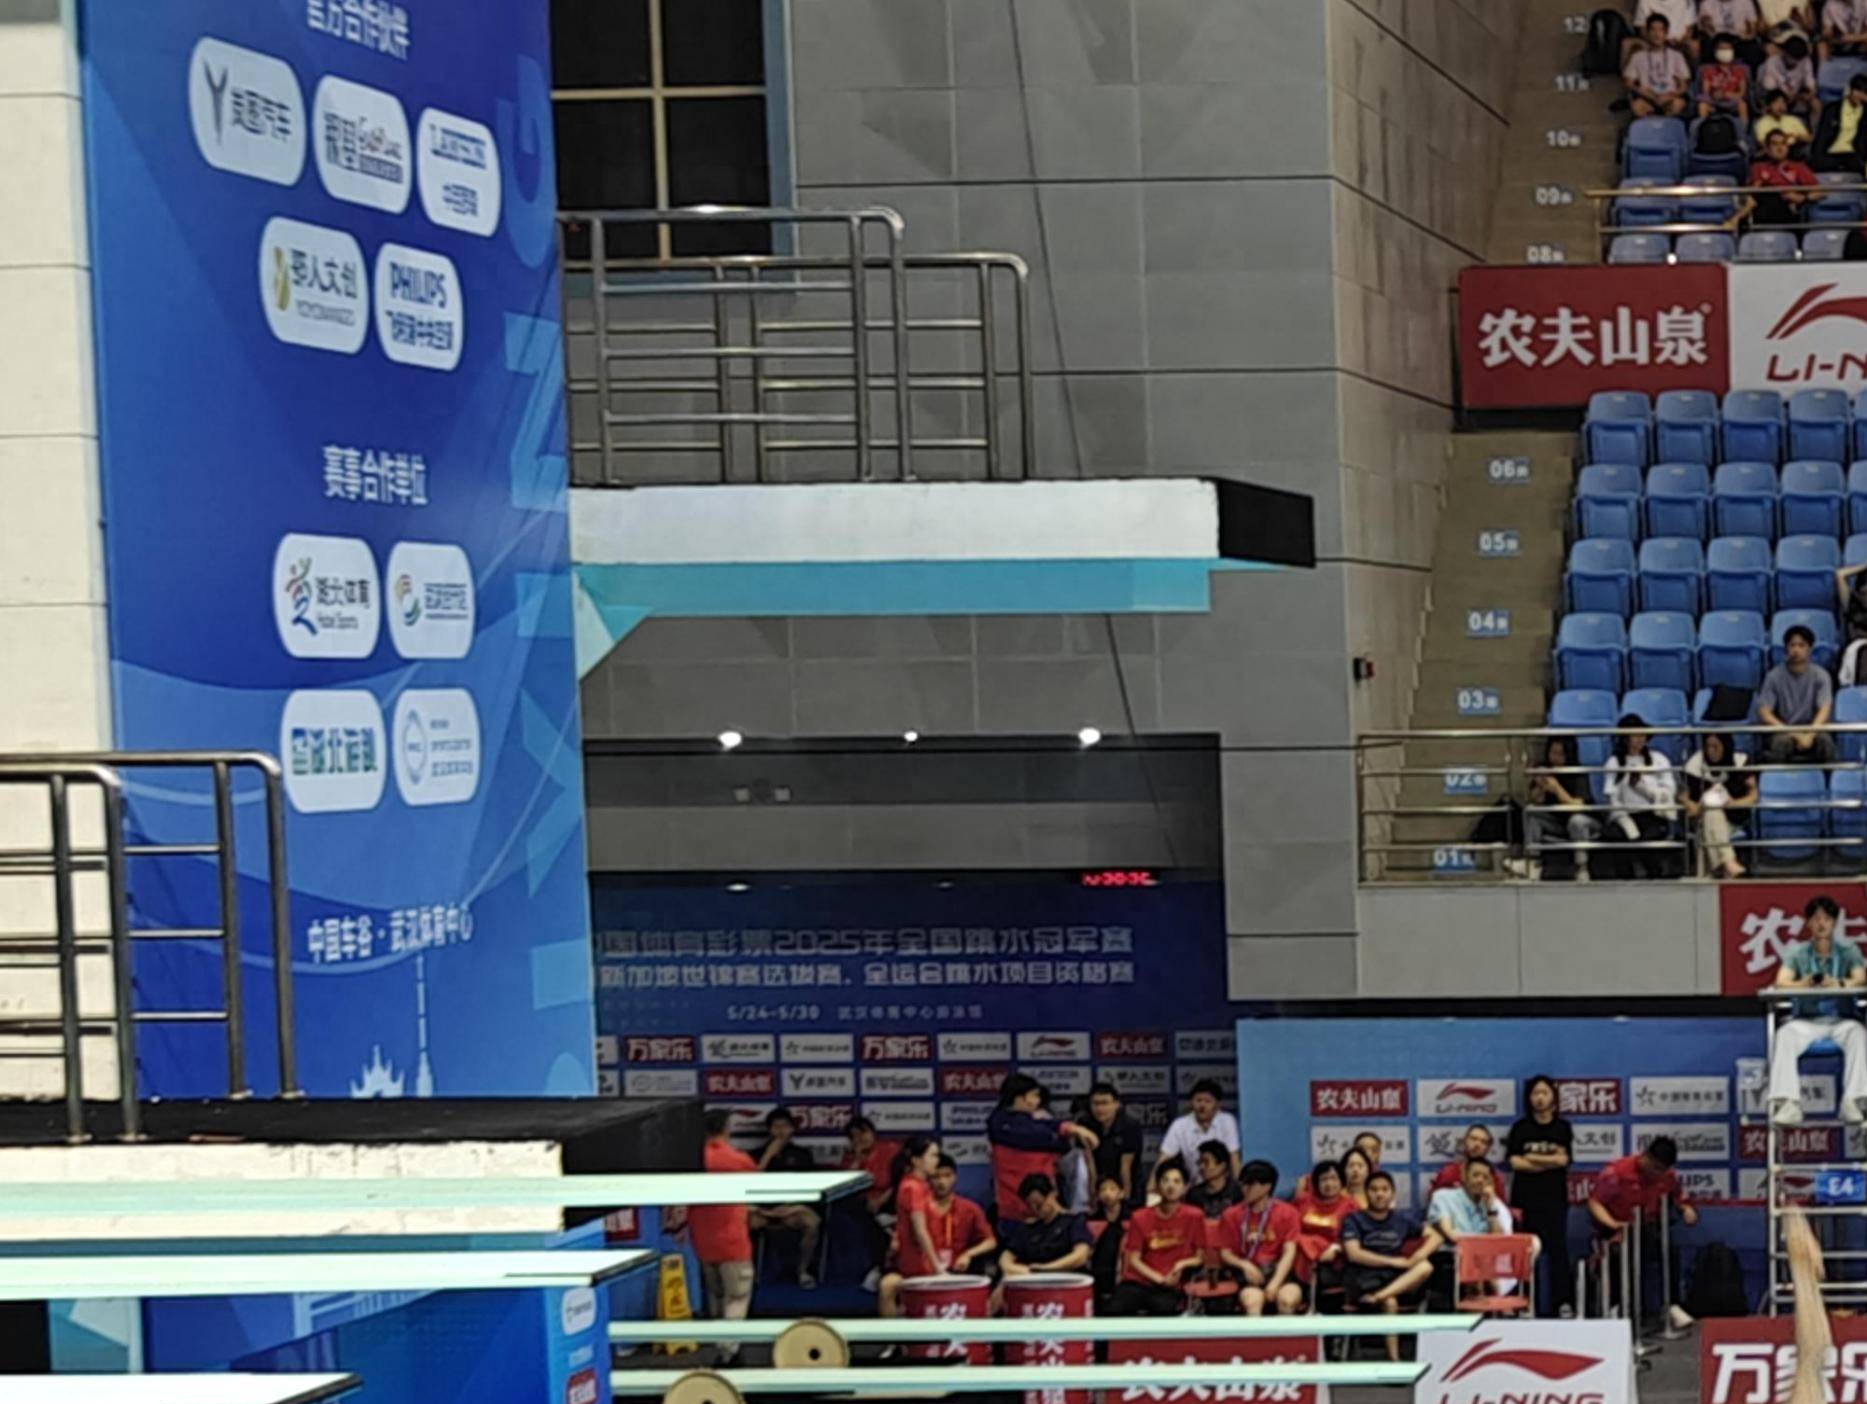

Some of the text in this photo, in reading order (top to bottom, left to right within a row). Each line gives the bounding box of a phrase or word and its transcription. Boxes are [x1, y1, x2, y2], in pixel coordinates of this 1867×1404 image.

[1478, 307, 1708, 367] 农夫山泉
[595, 926, 1134, 957] 国体育彩票2025年全国跳水冠军赛
[627, 1037, 693, 1061] 万家乐
[863, 1035, 929, 1060] 万家乐
[1317, 1086, 1402, 1110] 农夫山泉
[1558, 1080, 1618, 1113] 家乐
[1827, 1177, 1856, 1195] E4
